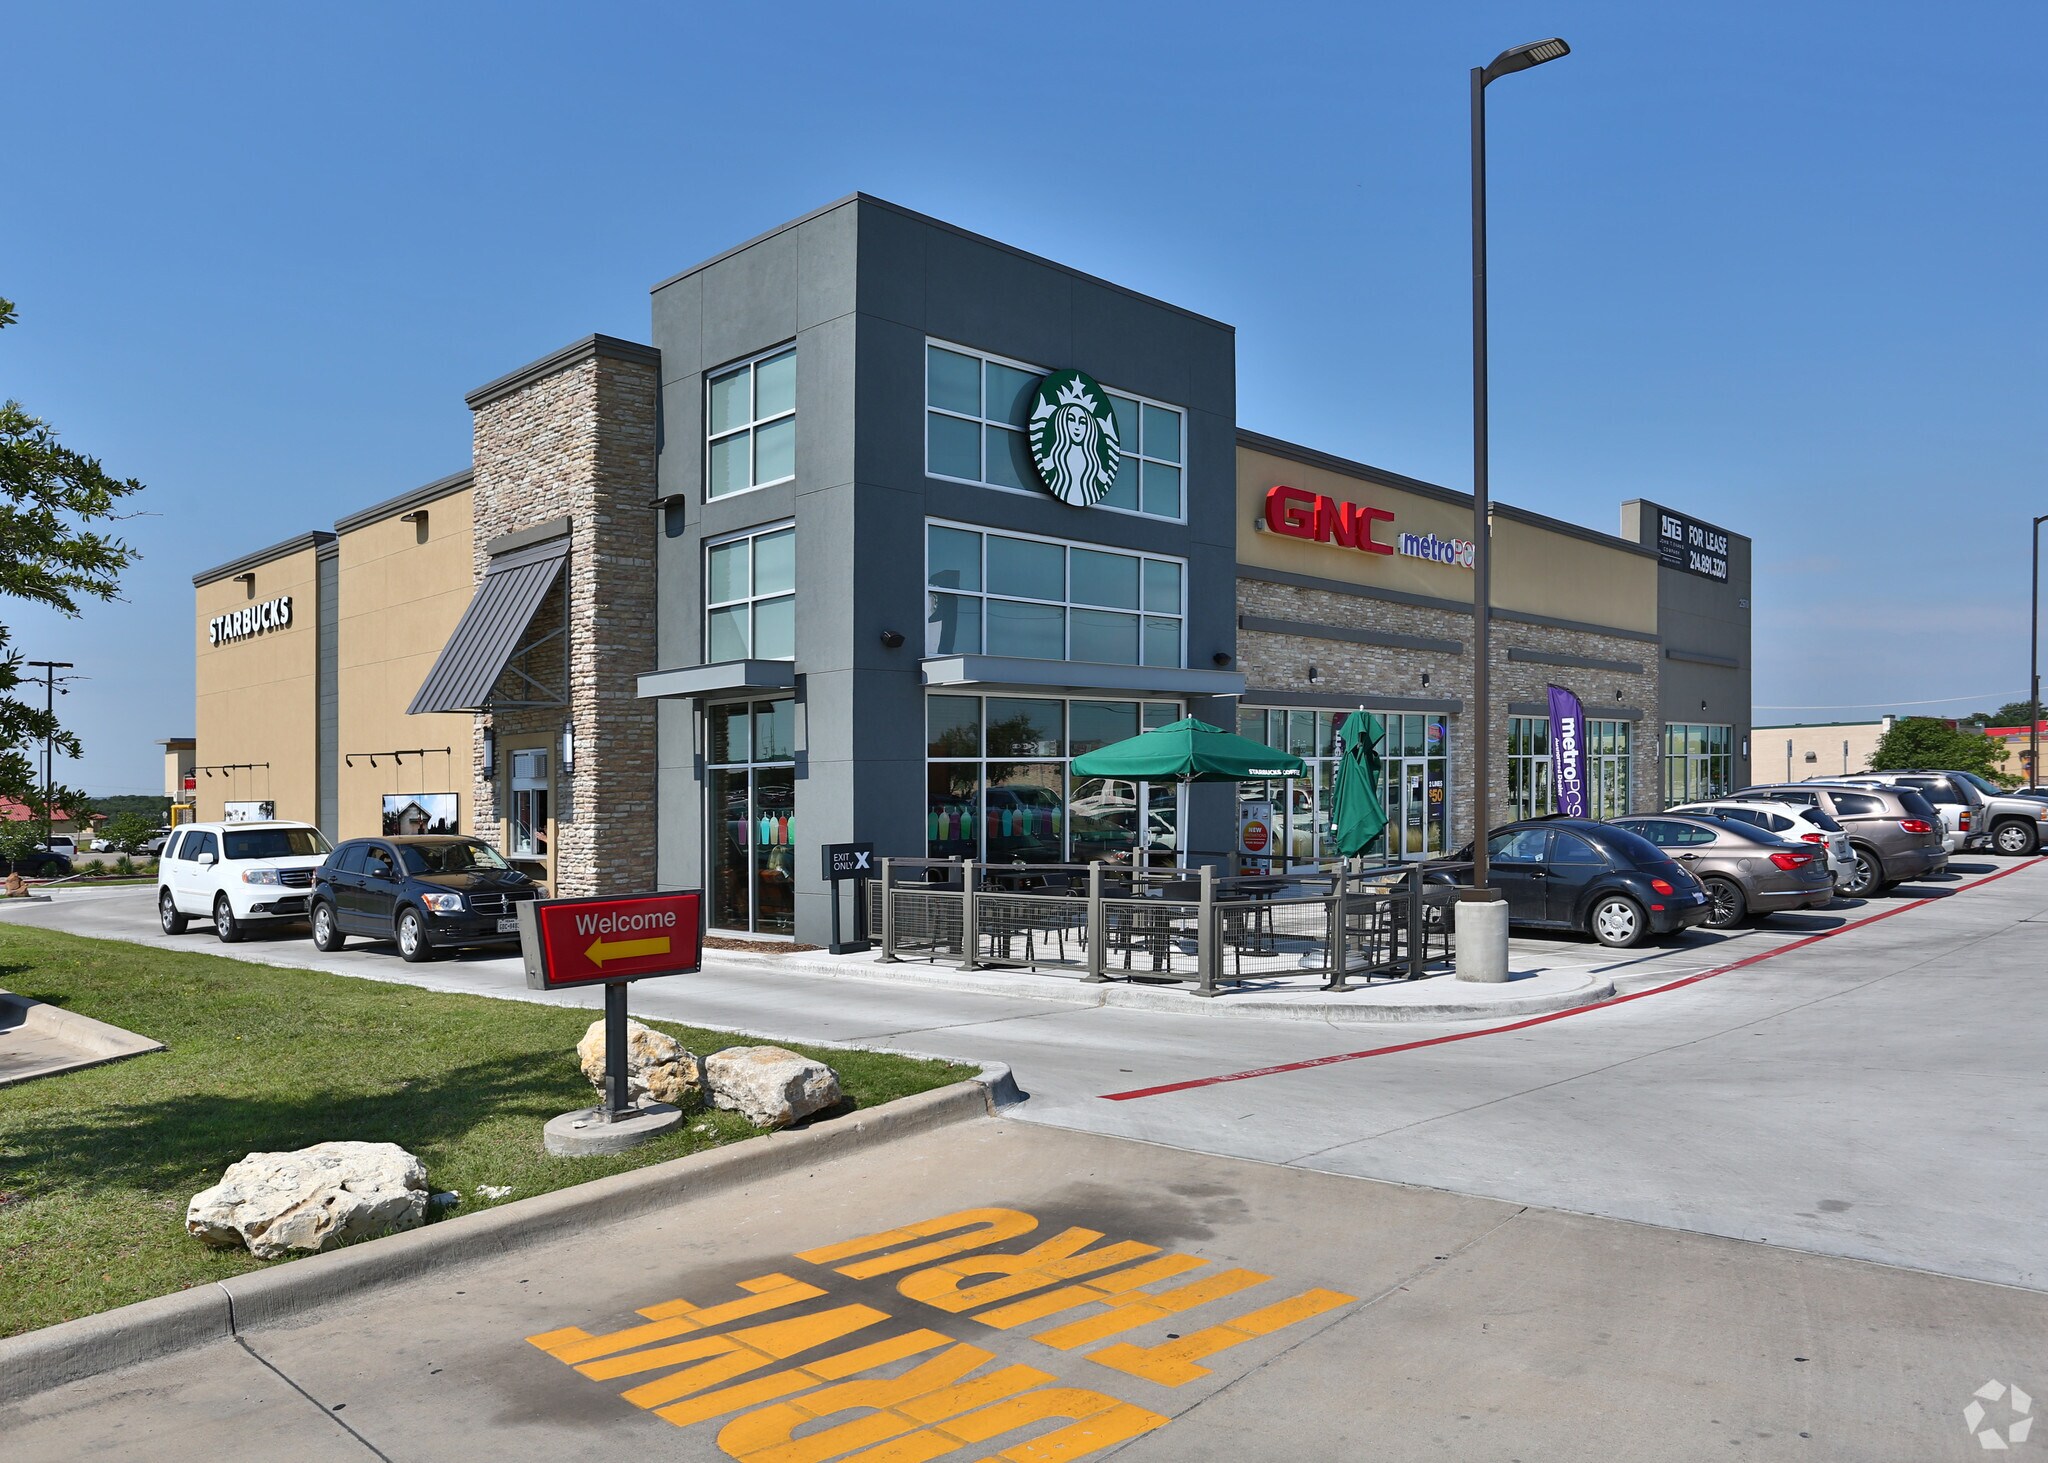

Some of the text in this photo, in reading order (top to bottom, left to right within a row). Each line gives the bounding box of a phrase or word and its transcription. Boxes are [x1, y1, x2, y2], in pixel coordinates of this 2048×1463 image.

[1265, 485, 1395, 556] GNC
[1402, 533, 1475, 569] metroPC
[1688, 525, 1727, 556] FOR LEASE
[209, 596, 289, 643] STARBUCKS
[1248, 768, 1282, 776] STARBUCKS
[1561, 717, 1582, 817] metroPCS
[1429, 788, 1443, 803] $50
[833, 853, 850, 862] EXIT
[833, 861, 854, 871] ONLY
[575, 911, 676, 936] Welcome
[793, 1207, 1358, 1388] THRU
